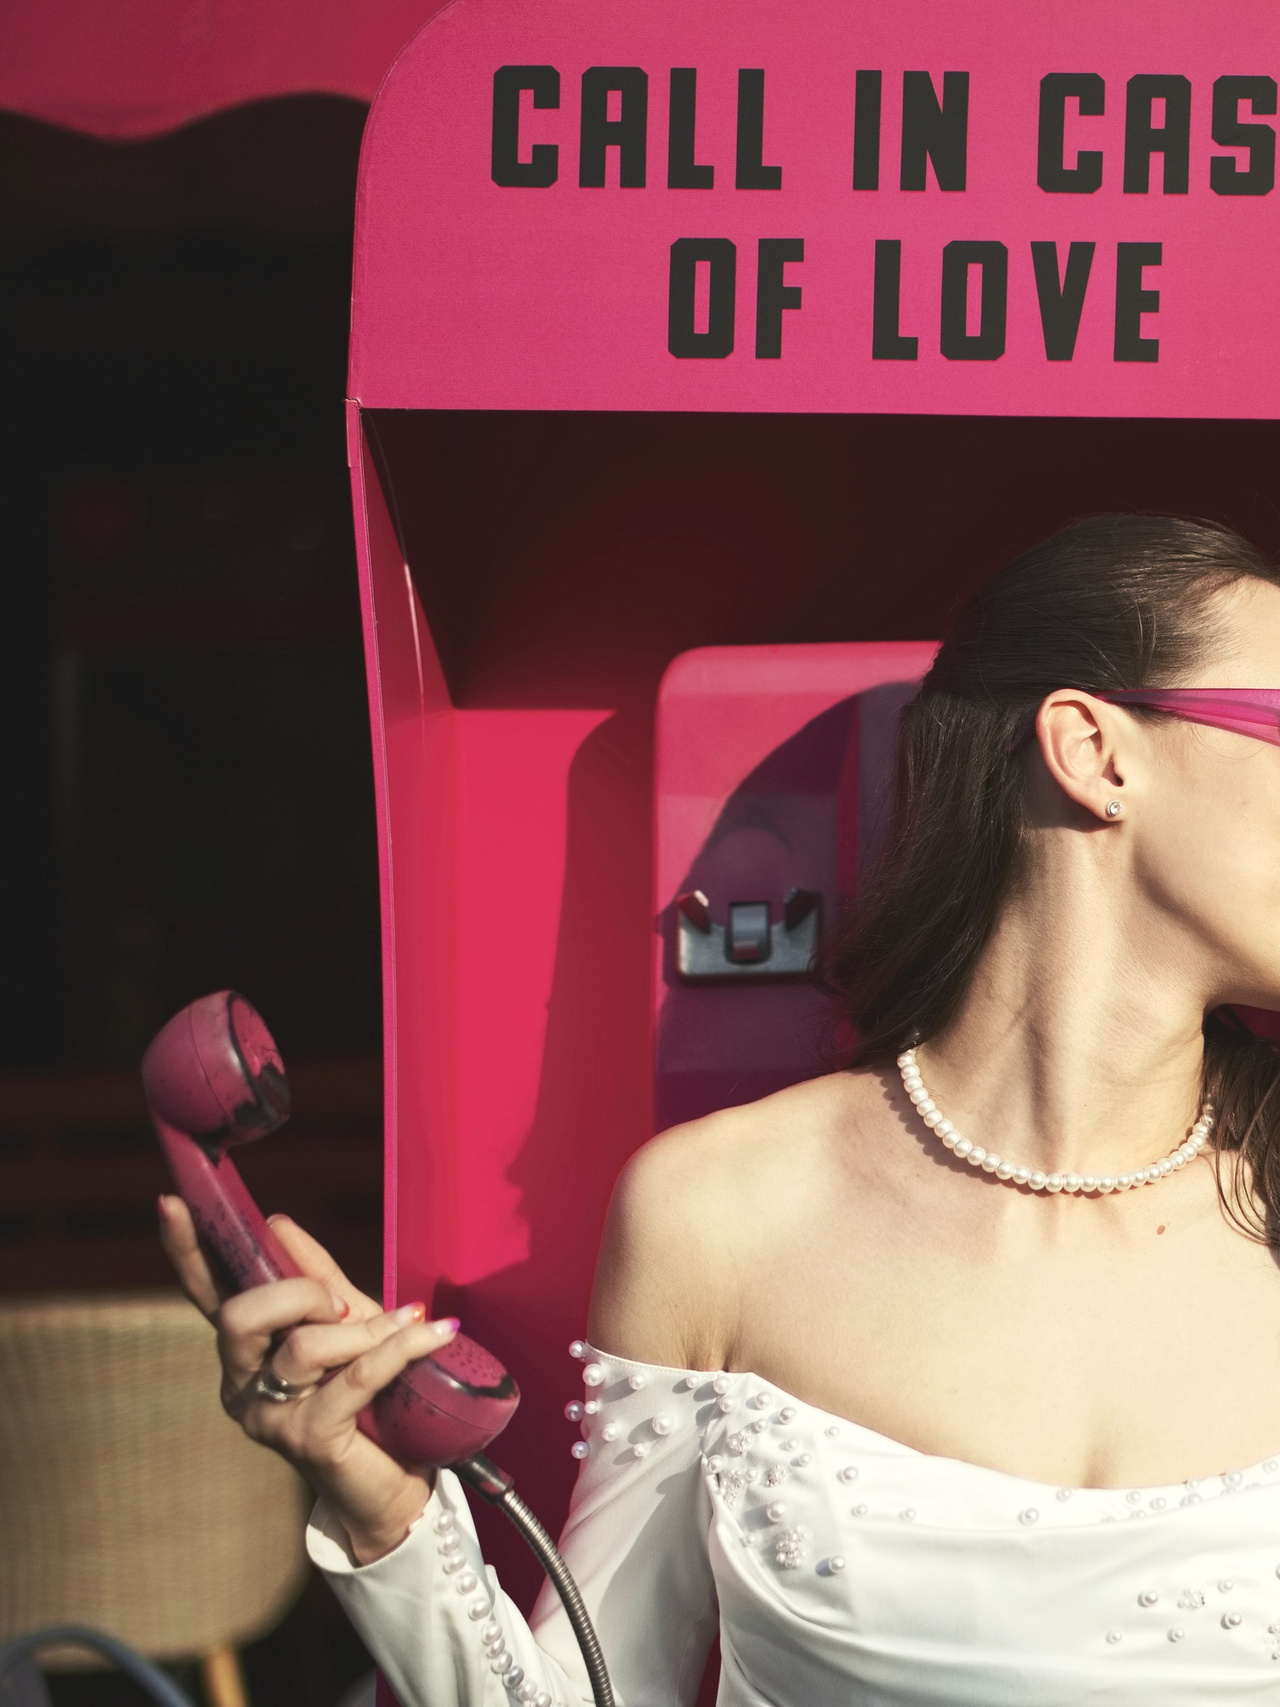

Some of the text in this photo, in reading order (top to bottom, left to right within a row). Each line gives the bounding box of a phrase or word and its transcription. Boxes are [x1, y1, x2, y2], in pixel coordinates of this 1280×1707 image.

[491, 65, 783, 191] CALL
[853, 70, 970, 192] IN
[668, 238, 1163, 363] OF LOVE
